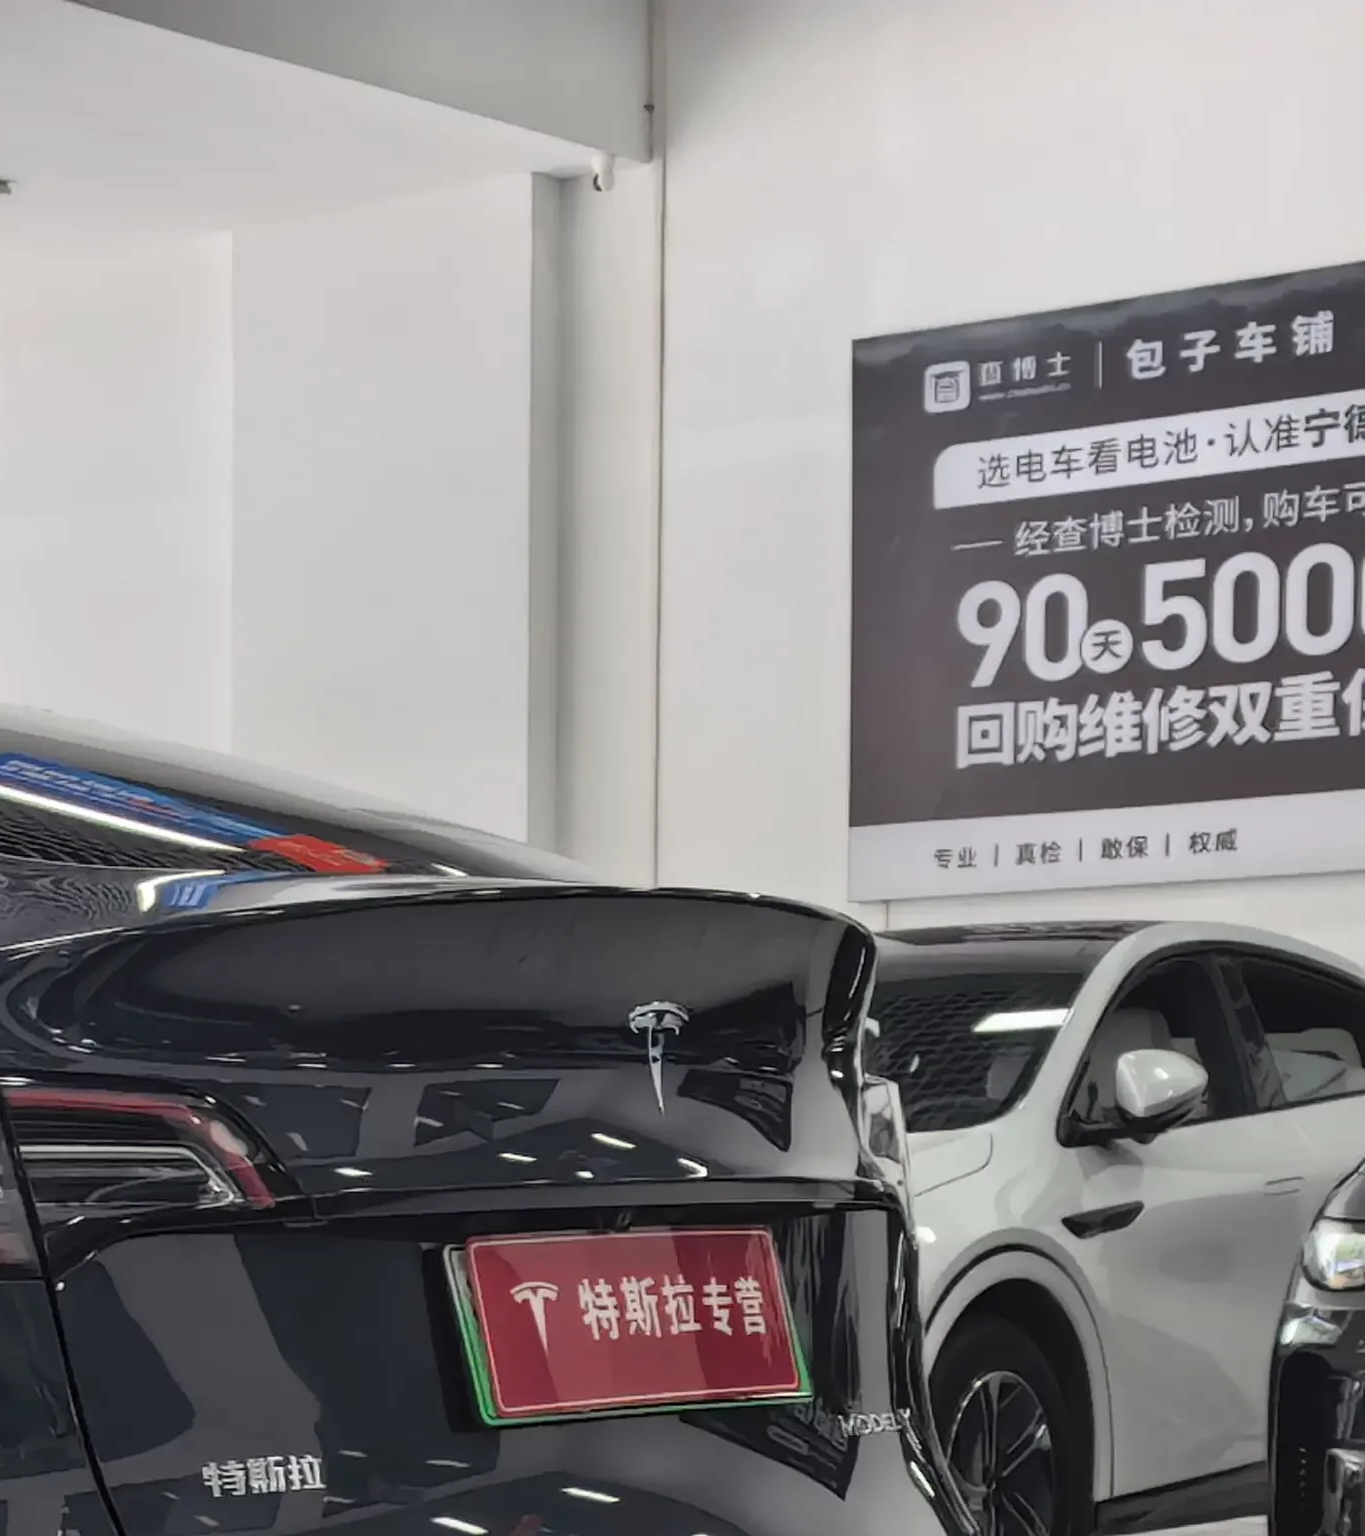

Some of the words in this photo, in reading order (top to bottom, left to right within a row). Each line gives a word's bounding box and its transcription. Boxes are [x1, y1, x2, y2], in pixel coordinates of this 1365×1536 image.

[1126, 311, 1334, 380] 包子车铺
[934, 846, 977, 869] 专业
[1189, 828, 1238, 855] 权威
[577, 1273, 768, 1341] 特斯拉专营
[201, 1454, 327, 1498] 特斯拉
